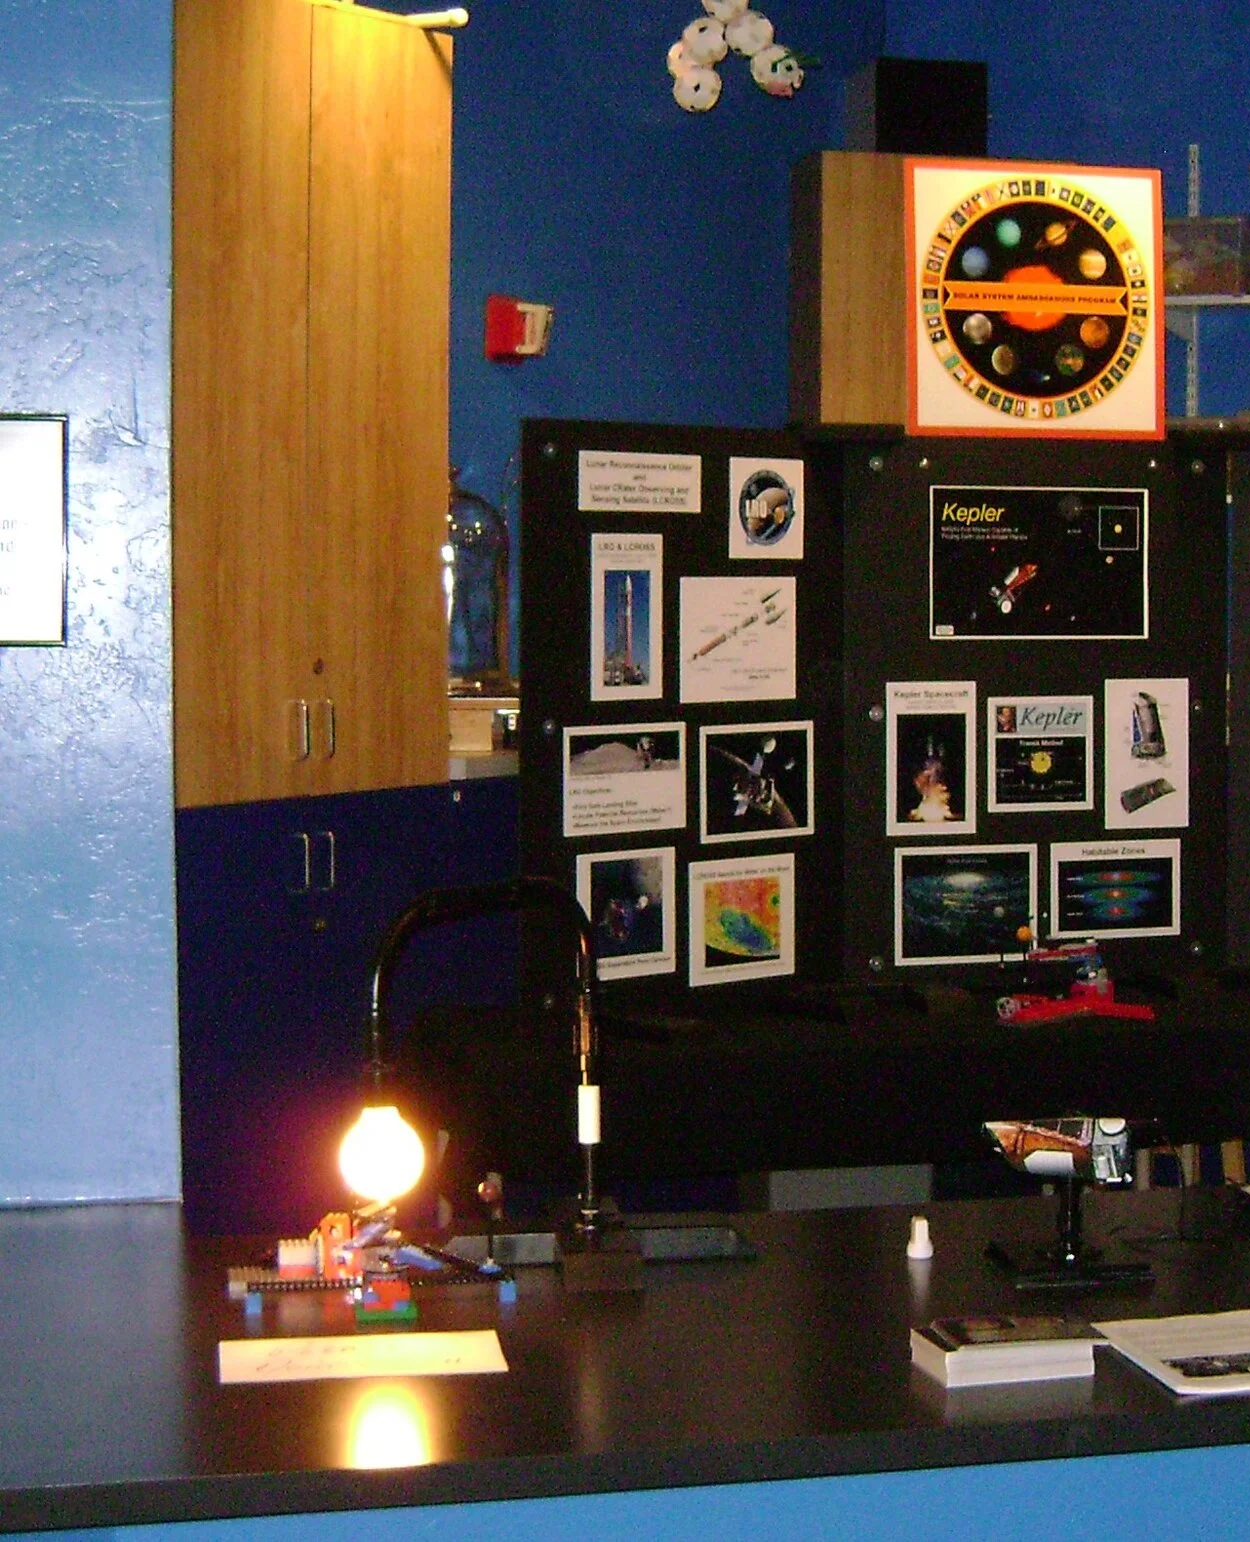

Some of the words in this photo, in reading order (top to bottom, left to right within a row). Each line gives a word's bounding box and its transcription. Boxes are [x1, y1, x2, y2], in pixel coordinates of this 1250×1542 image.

[954, 291, 979, 299] SOLAR
[982, 292, 1014, 300] SYSTEM
[1078, 296, 1117, 304] PROGRAM
[942, 502, 1005, 526] Kepler
[598, 543, 615, 551] LRO
[894, 690, 921, 699] Kepler
[924, 690, 969, 699] Spacecraft
[1020, 706, 1083, 732] Kepler
